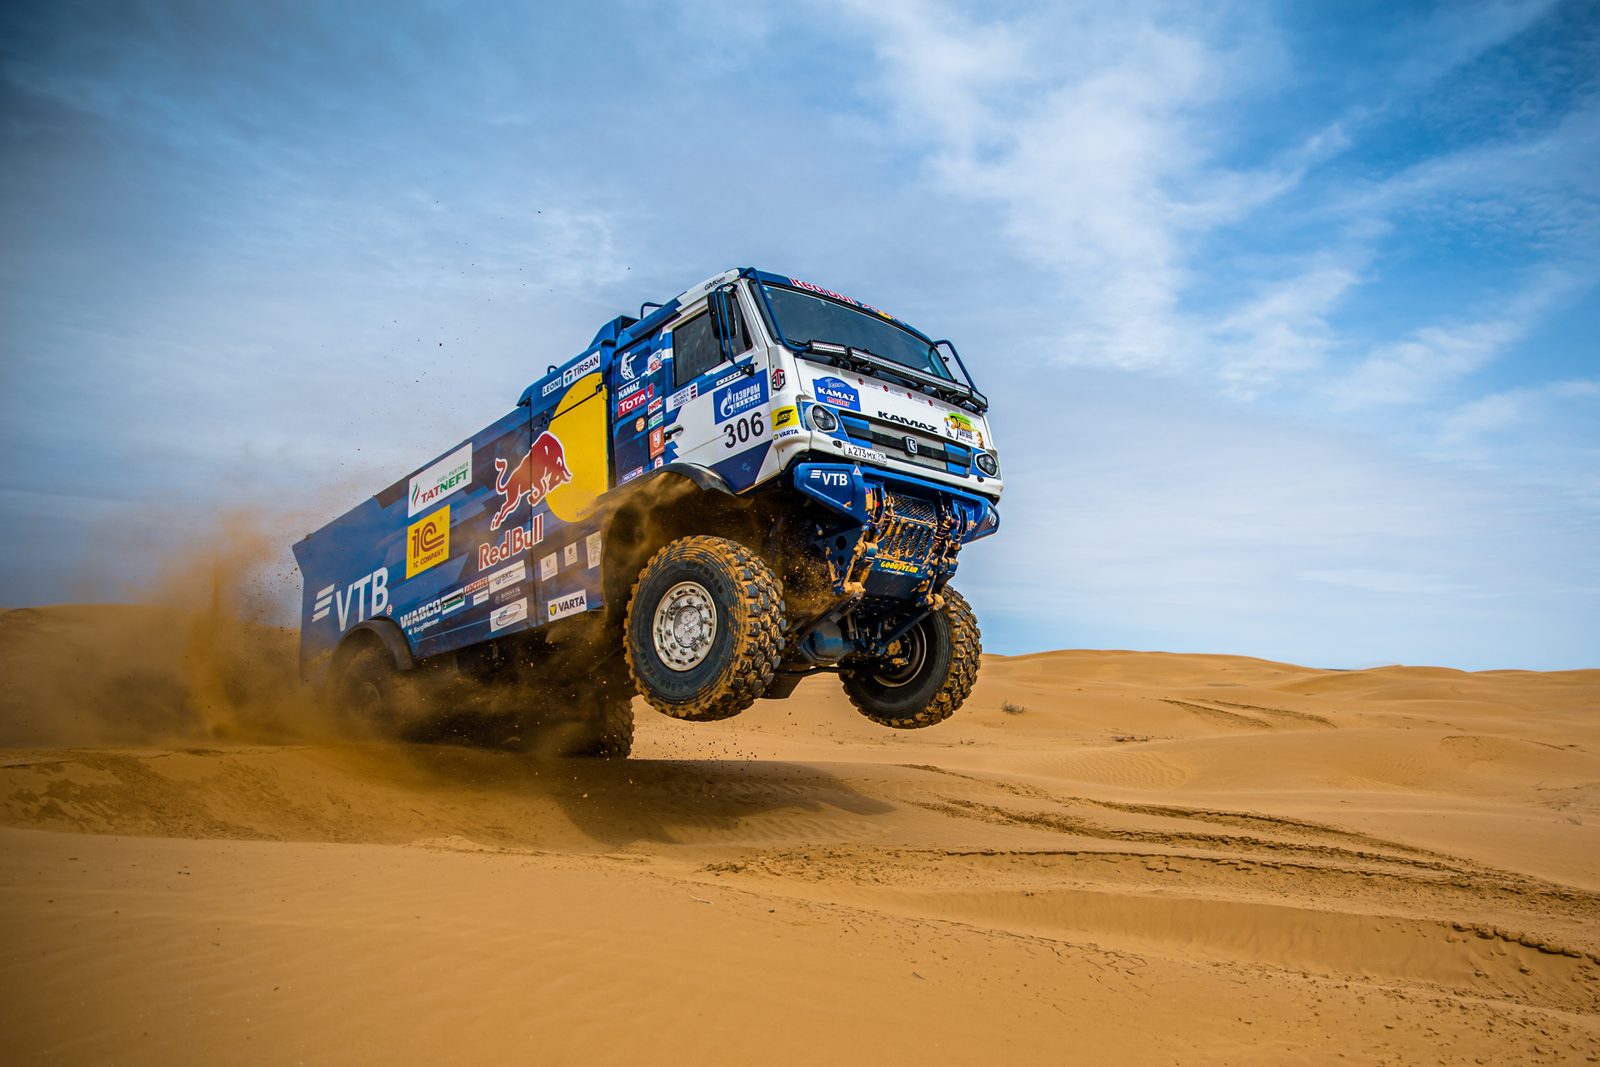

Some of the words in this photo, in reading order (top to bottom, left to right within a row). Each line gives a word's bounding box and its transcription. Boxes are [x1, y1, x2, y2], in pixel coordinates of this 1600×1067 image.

[543, 379, 561, 395] LEONI
[618, 381, 640, 400] KAMAZ
[732, 383, 760, 403] ГАЗПРОМ
[817, 386, 856, 402] KAMAZ
[620, 391, 653, 413] TOTAL
[723, 411, 764, 449] 306
[877, 411, 938, 433] KAMAZ
[779, 429, 799, 438] VARTA
[421, 468, 469, 503] TATNEFT
[821, 472, 848, 486] VTB
[479, 529, 511, 572] Red
[511, 512, 544, 556] Bull
[420, 547, 444, 565] COMPANY
[880, 561, 919, 574] GOODYEAR
[465, 578, 488, 594] LOCTITE
[336, 566, 389, 632] VTB
[558, 596, 585, 612] VARTA
[400, 599, 441, 629] WABCO
